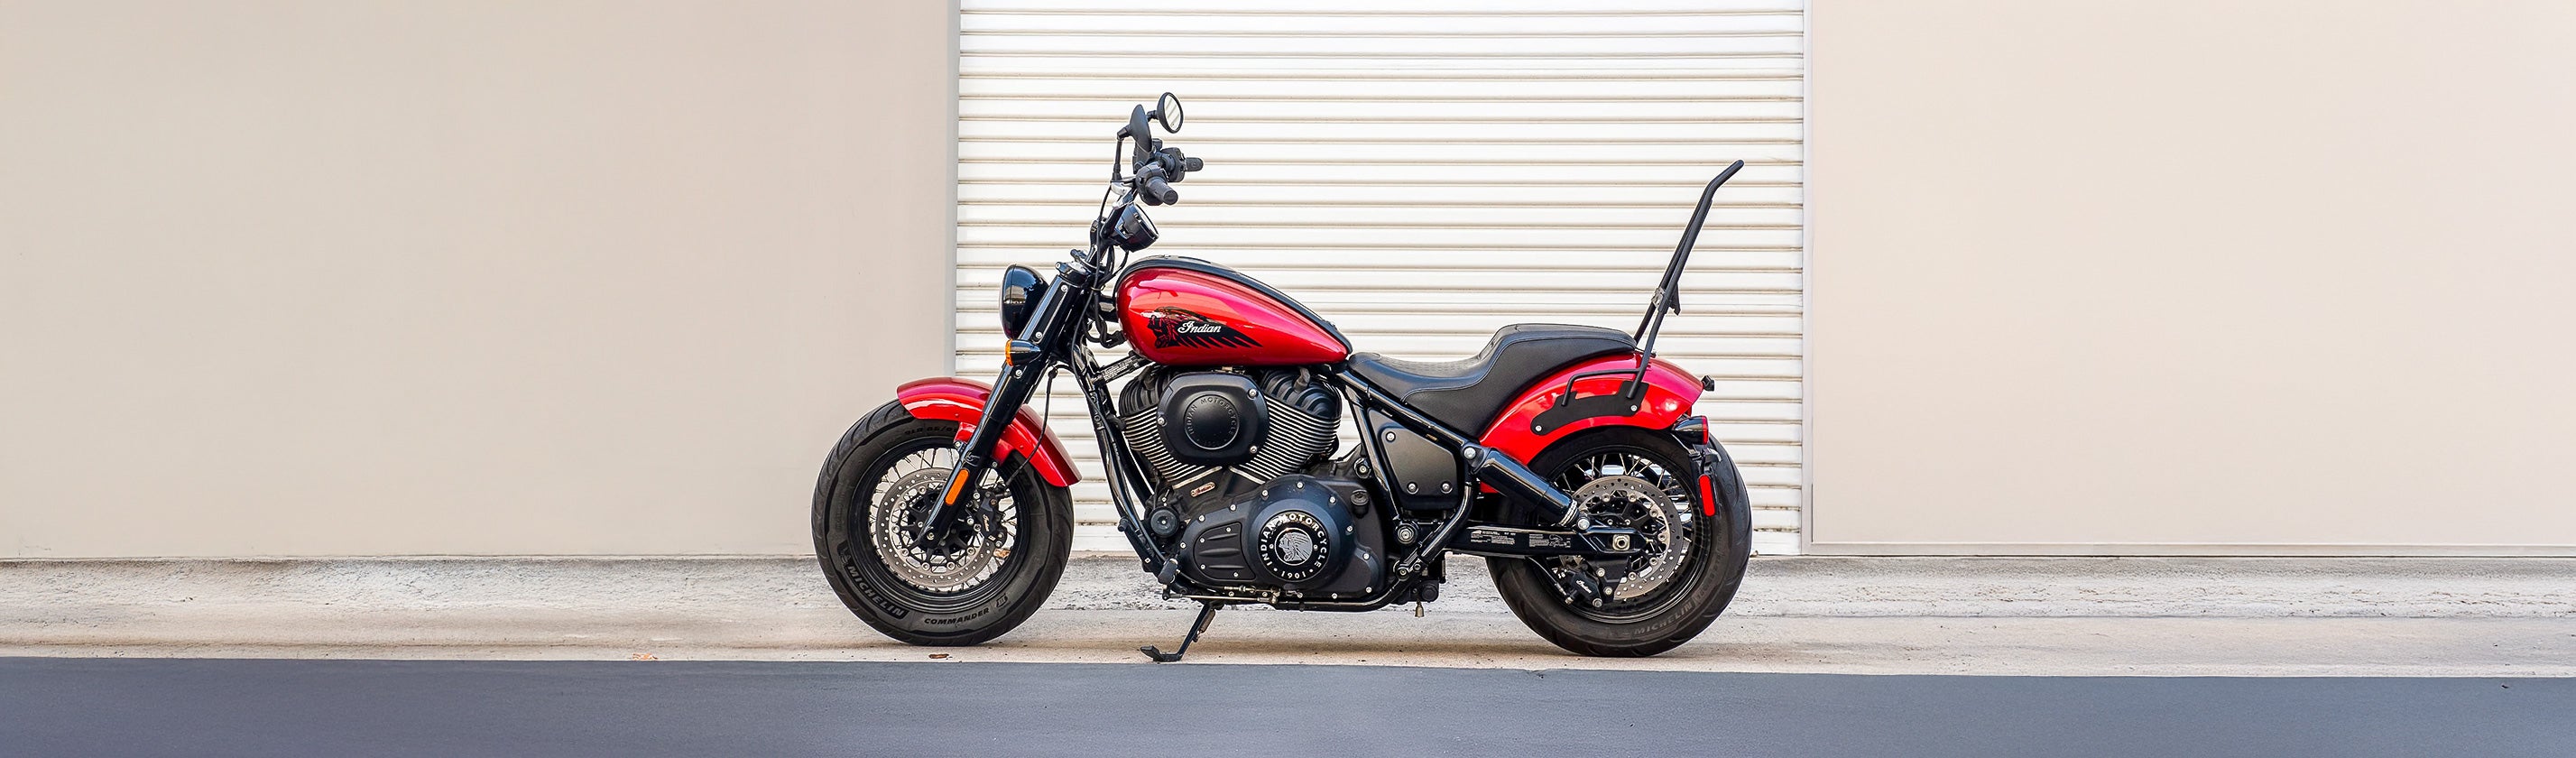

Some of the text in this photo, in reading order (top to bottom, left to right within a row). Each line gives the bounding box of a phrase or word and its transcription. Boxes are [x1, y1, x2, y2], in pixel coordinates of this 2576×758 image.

[1177, 320, 1222, 333] Indian
[1186, 396, 1237, 435] INDIAN MOTORCYCLE
[1260, 513, 1327, 568] INDIAN MOTORCYCLE
[1281, 570, 1306, 578] 1901
[847, 565, 905, 617] MICHELIN
[924, 607, 990, 625] COMMANDER
[1634, 602, 1693, 634] MICHELIN
